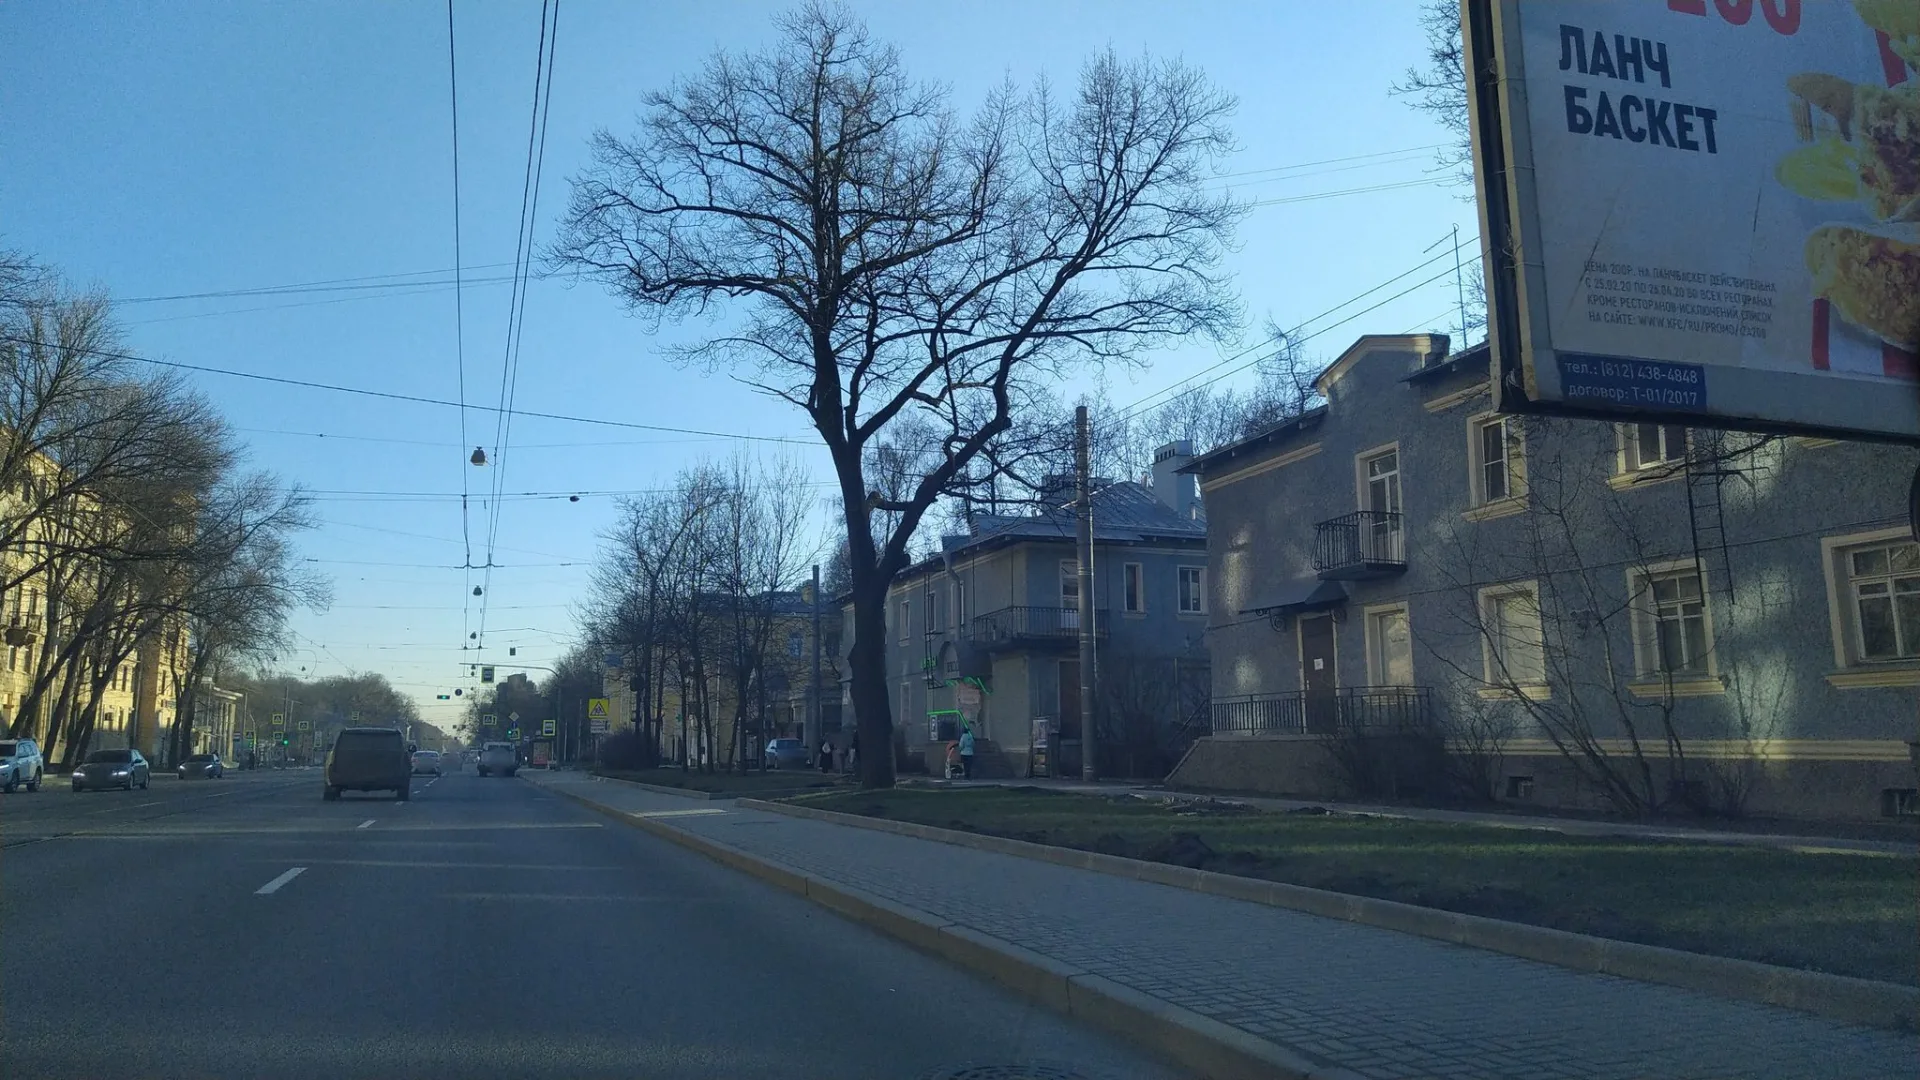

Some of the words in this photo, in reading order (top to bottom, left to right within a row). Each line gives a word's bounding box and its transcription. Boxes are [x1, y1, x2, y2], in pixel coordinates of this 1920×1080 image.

[1559, 24, 1671, 88] ЛАНЧ
[1564, 85, 1717, 154] БАСКЕТ
[1583, 260, 1608, 274] ЦЕНА
[1638, 266, 1650, 277] НА
[1594, 278, 1632, 292] 25.02.20
[1634, 281, 1647, 294] ПО
[1699, 288, 1721, 301] ВСЕХ
[1587, 294, 1618, 308] КРОМЕ
[1588, 311, 1602, 322] НА
[1564, 362, 1598, 375] тел.:
[1600, 361, 1635, 379] (812)
[1637, 365, 1698, 384] 438-4848
[1567, 384, 1629, 402] договор:
[1630, 386, 1698, 406] Т-01/2017
